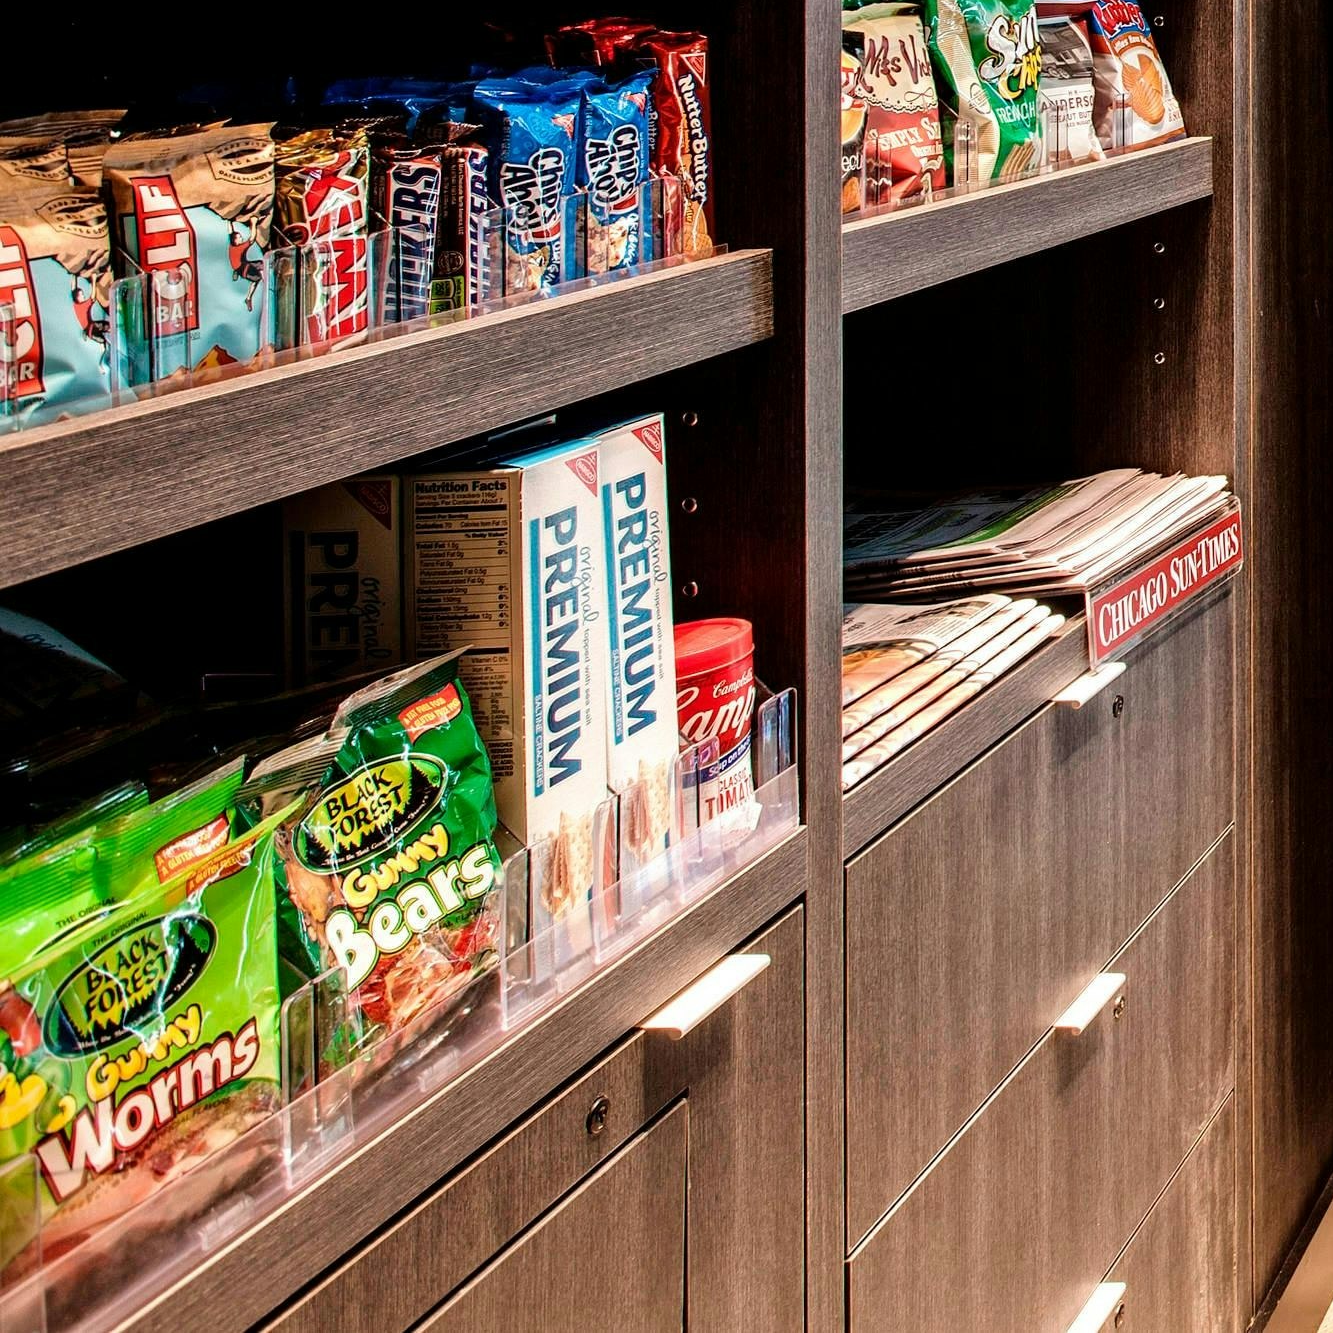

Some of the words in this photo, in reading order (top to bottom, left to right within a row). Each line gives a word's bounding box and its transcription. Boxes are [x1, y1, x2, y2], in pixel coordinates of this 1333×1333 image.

[678, 73, 703, 144] Nutter
[612, 126, 641, 198] Chips
[689, 138, 710, 202] Butter
[138, 184, 192, 300] CLIF
[415, 481, 469, 494] Nutrition
[471, 480, 508, 492] Facts
[643, 509, 669, 587] original
[1097, 572, 1168, 648] CHICAGO
[1168, 521, 1241, 600] SUN-TIMES
[571, 546, 600, 626] original
[616, 471, 657, 737] PREMIUM
[545, 505, 583, 788] PREMIUM
[615, 684, 624, 737] CRACKERS
[326, 767, 393, 823] BLACK
[536, 736, 545, 789] CRACKERS
[331, 785, 405, 846] FOREST
[341, 822, 450, 910] Gummy
[325, 843, 496, 993] Bears
[85, 951, 170, 1020] FOREST
[86, 929, 161, 995] BLACK
[86, 1003, 203, 1102] Gummy
[37, 1017, 259, 1204] Worms
